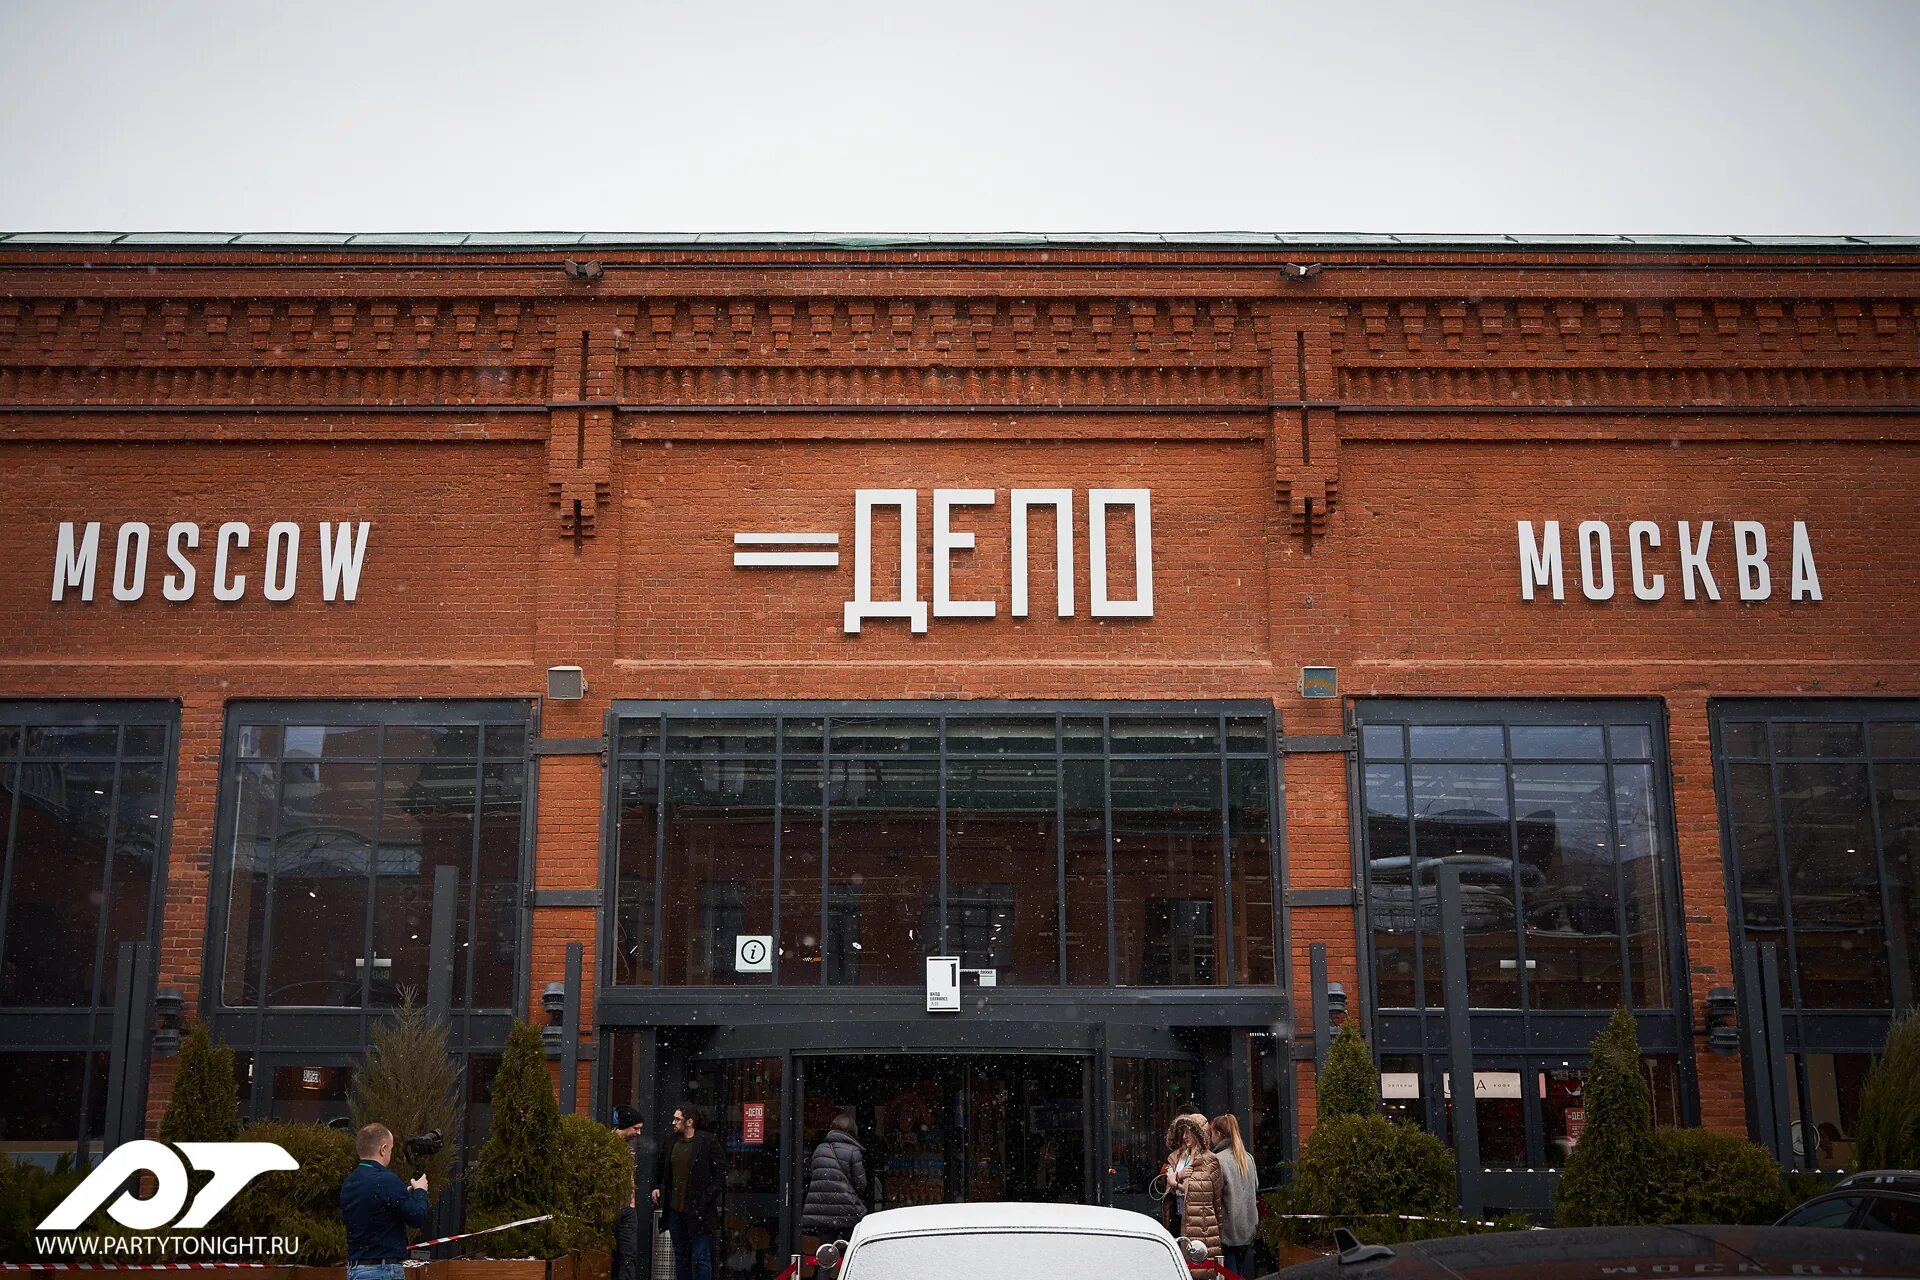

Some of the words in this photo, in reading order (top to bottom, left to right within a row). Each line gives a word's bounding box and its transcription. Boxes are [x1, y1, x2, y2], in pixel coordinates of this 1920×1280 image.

[51, 521, 371, 602] MOSCOW
[1516, 520, 1823, 601] МОСКВА
[950, 963, 957, 987] 1
